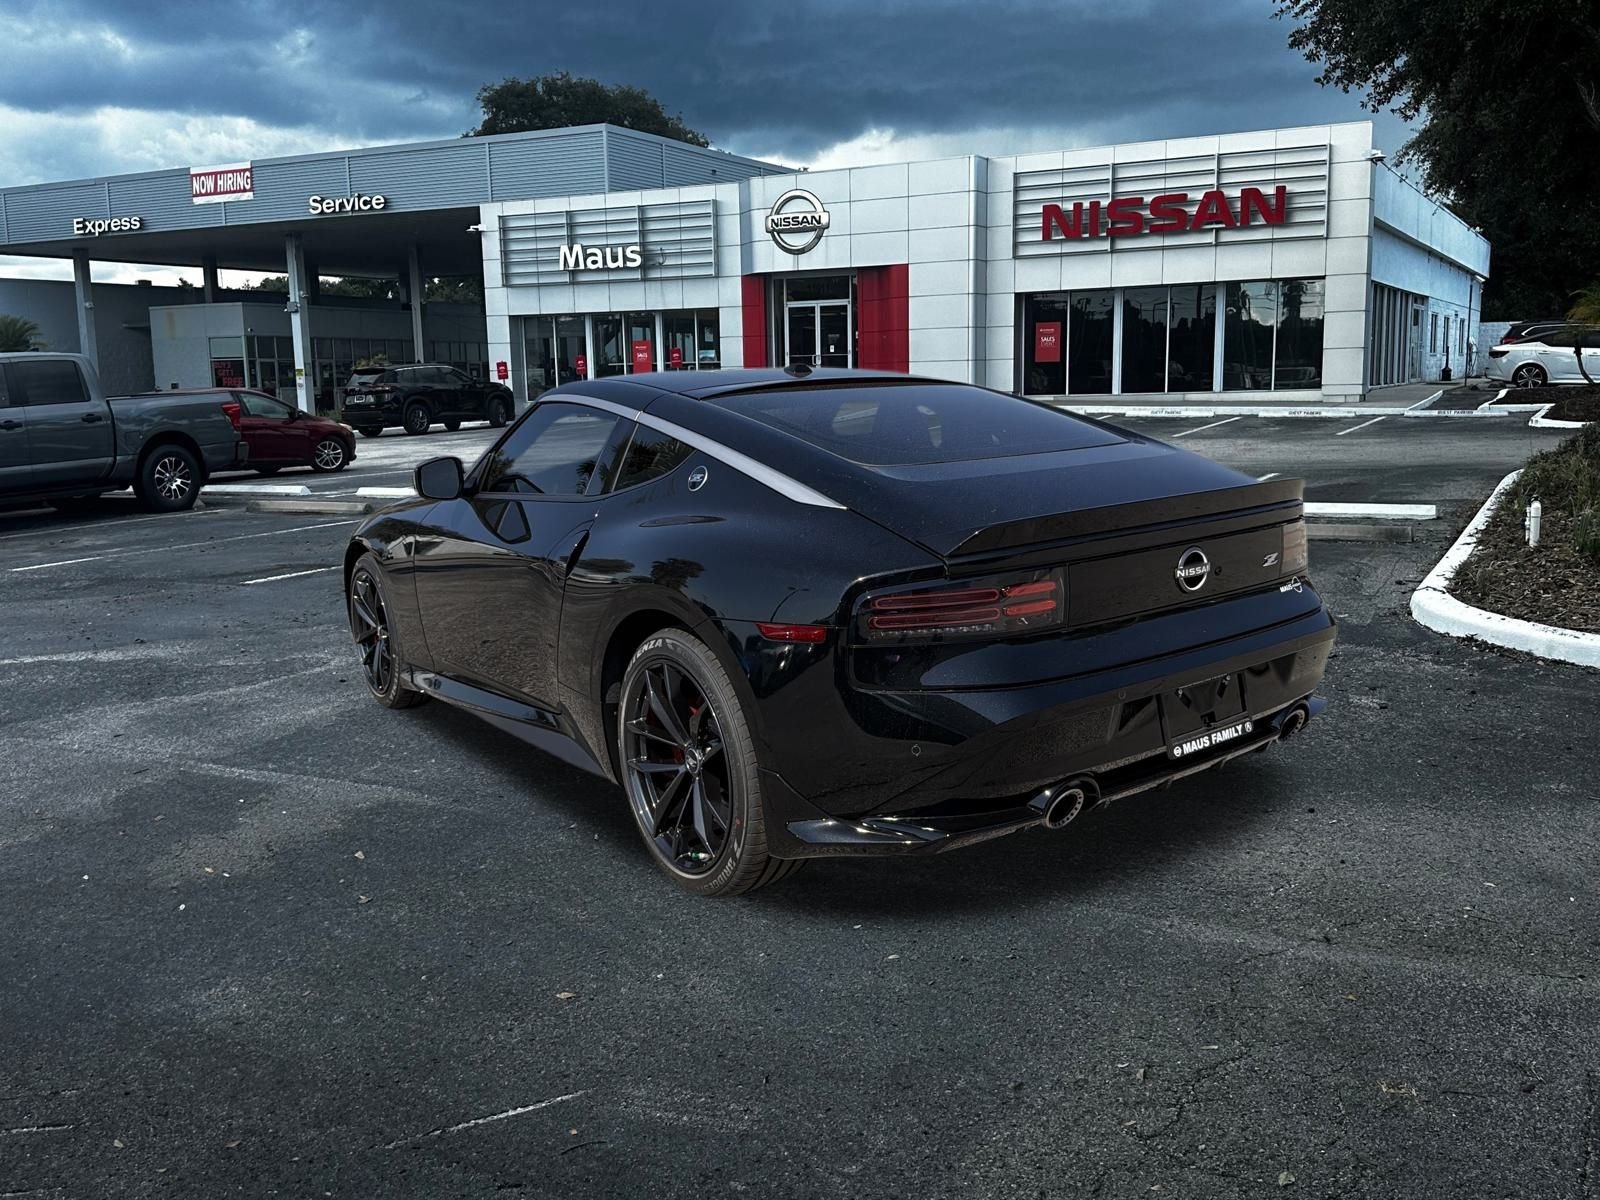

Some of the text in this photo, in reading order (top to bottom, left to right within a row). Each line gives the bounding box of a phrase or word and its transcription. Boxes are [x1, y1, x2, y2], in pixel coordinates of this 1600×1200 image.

[192, 169, 251, 197] NOW HIRING
[308, 193, 386, 215] Service
[1041, 185, 1288, 242] NISSAN
[73, 215, 142, 237] Express
[769, 213, 823, 231] NISSAN
[559, 242, 643, 271] Maus
[1262, 552, 1279, 567] Z
[1182, 723, 1243, 755] MAUS FAMILY
